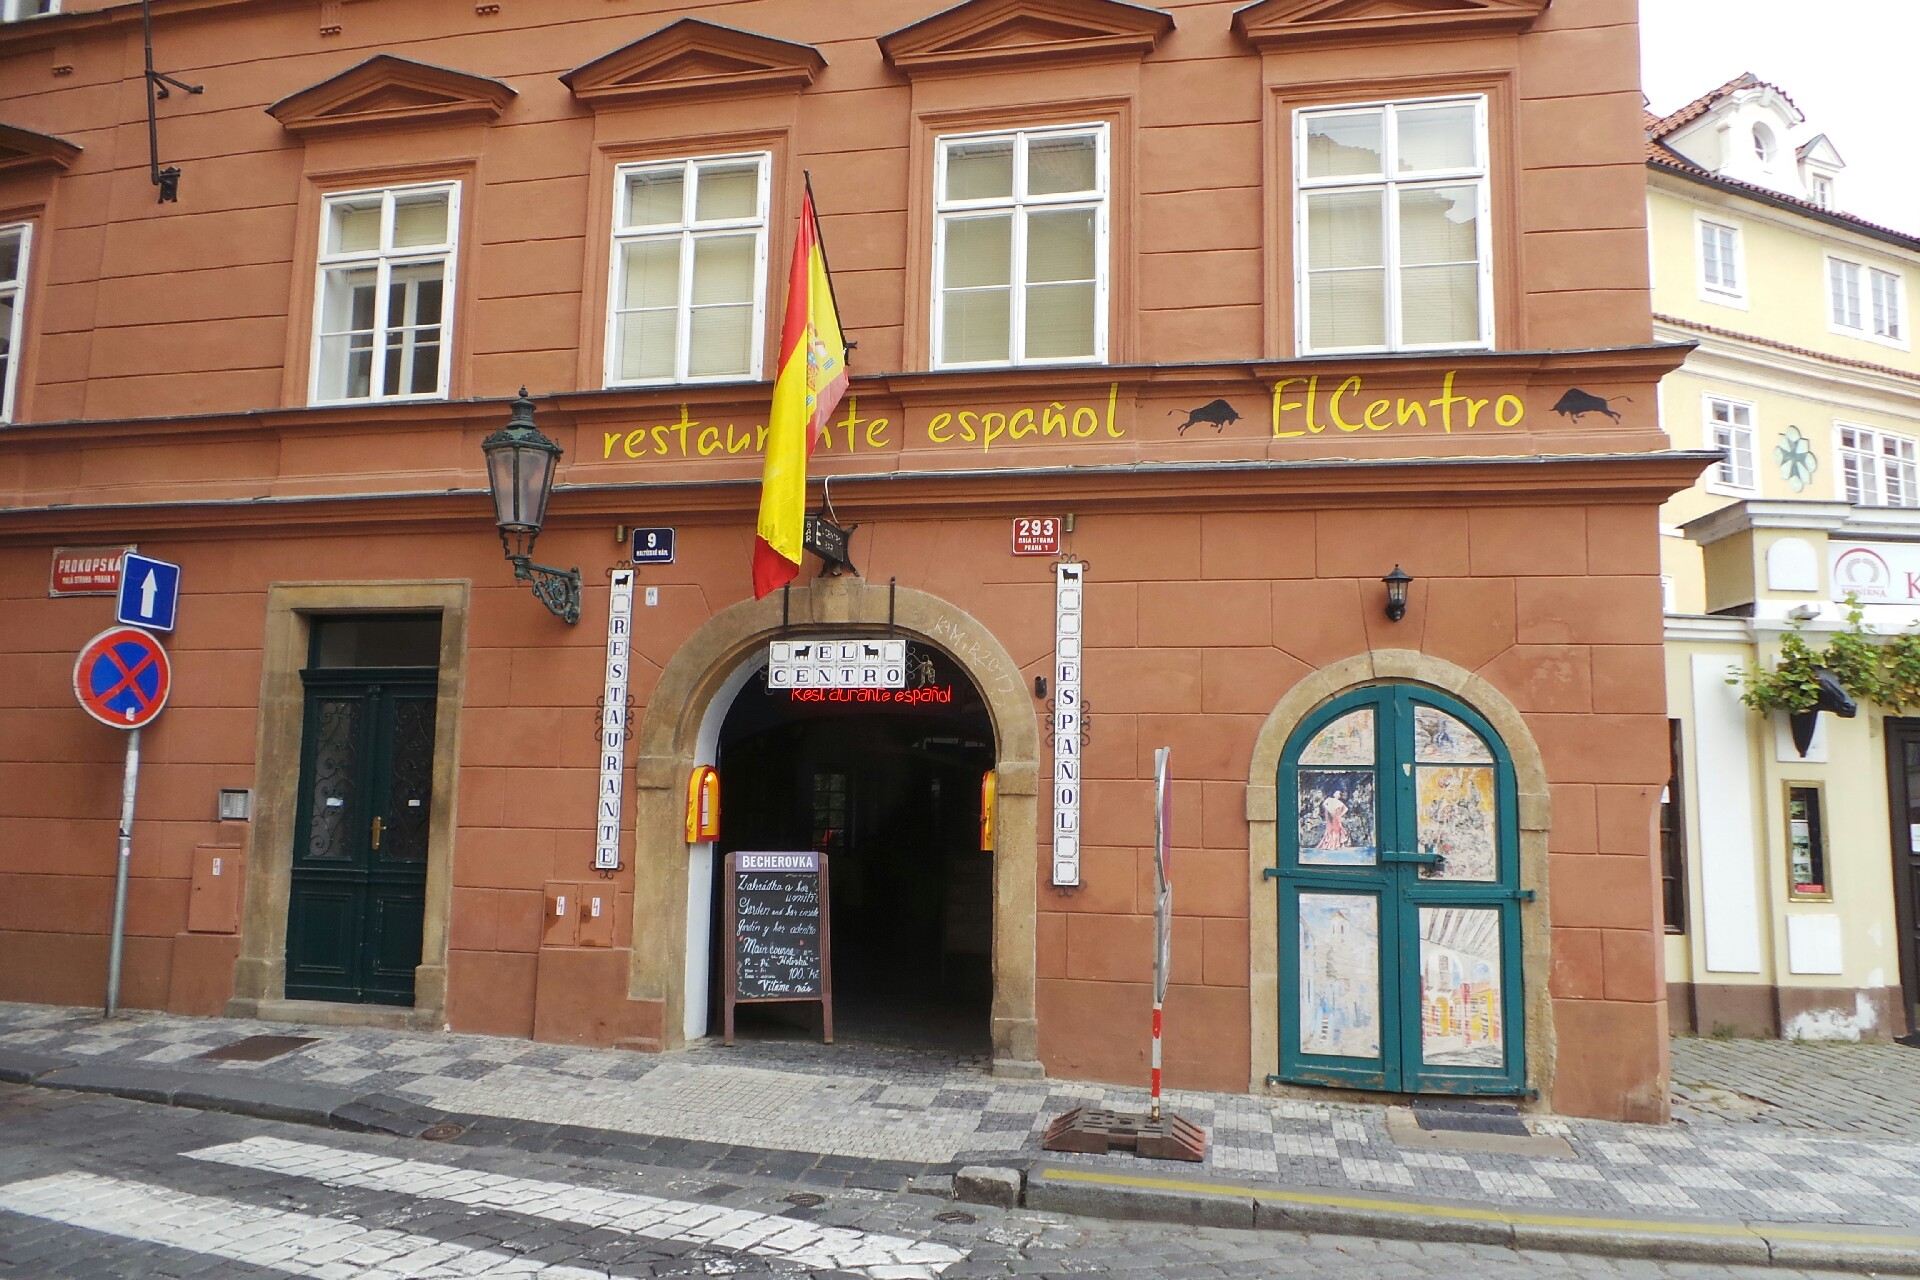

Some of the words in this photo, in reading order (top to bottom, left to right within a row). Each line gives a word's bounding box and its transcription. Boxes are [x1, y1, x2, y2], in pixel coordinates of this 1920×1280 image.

[928, 382, 1125, 454] español
[1019, 519, 1054, 536] 293
[647, 532, 657, 548] 9
[58, 555, 122, 573] PROKOPSKÁ
[818, 645, 855, 659] EL
[774, 669, 900, 683] CENTRO
[894, 685, 952, 706] español
[602, 619, 625, 863] RESTAURANTE
[1060, 665, 1075, 829] ESPAÑOL
[742, 855, 813, 868] BECHEROVKA
[738, 897, 771, 916] Garden
[762, 926, 769, 937] y
[743, 937, 768, 955] Main
